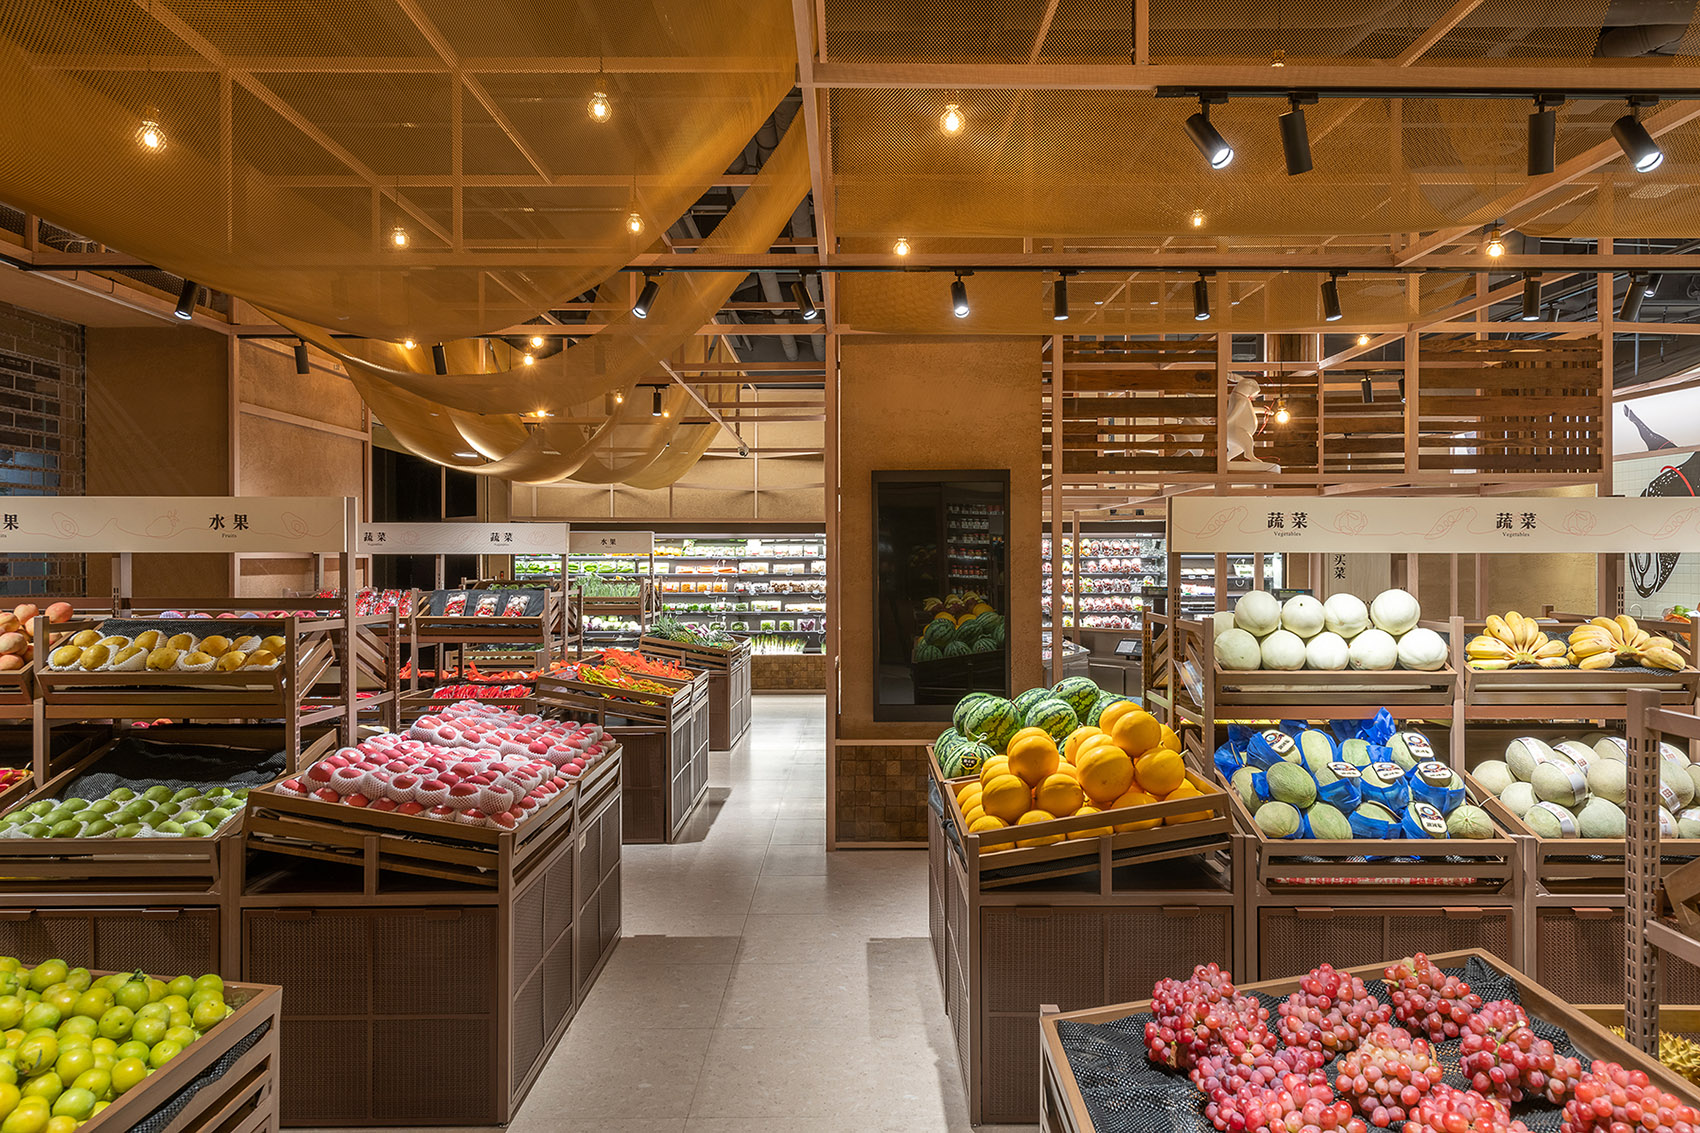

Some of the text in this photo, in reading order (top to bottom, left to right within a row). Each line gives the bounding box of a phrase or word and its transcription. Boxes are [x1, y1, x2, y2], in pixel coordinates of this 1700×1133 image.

[3, 513, 19, 531] 果
[208, 513, 249, 531] 水果
[1267, 511, 1308, 529] 蔬菜
[1496, 512, 1537, 529] 蔬菜
[363, 531, 387, 542] 蔬菜
[490, 532, 513, 542] 蔬菜
[600, 538, 617, 546] 水果
